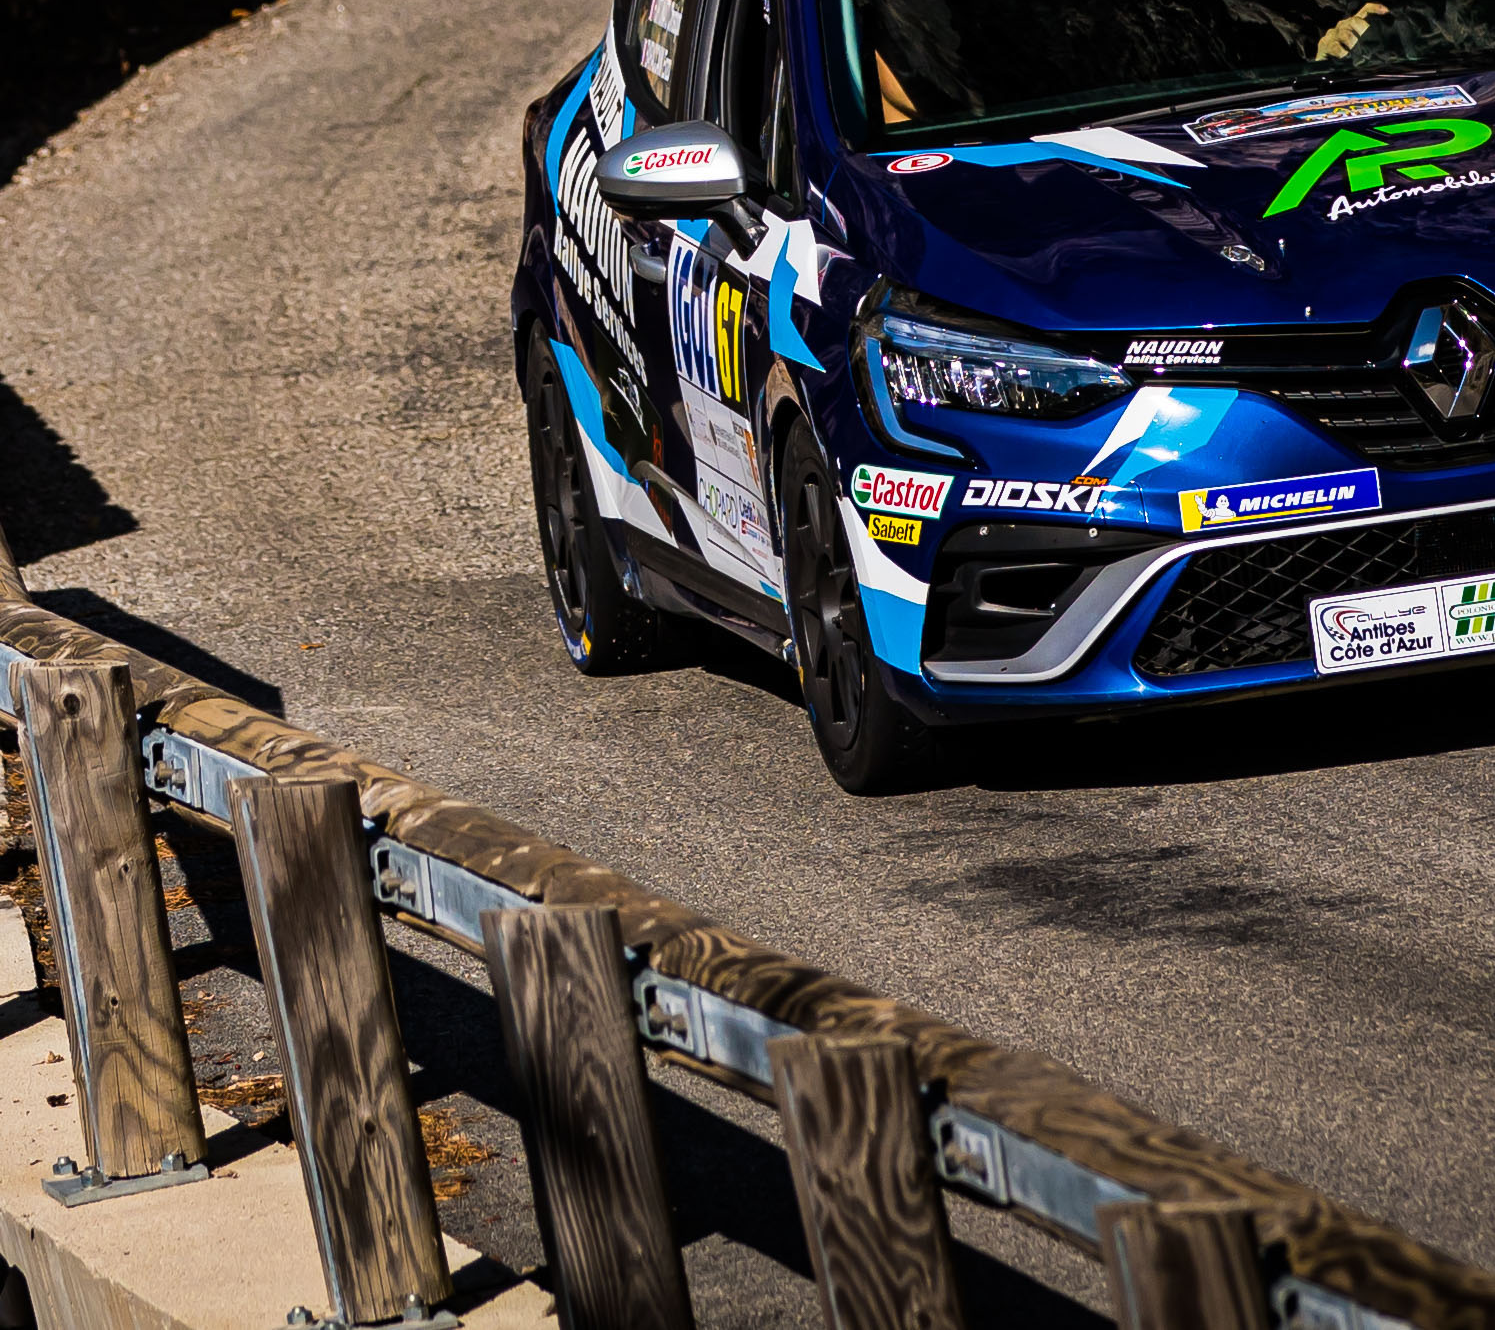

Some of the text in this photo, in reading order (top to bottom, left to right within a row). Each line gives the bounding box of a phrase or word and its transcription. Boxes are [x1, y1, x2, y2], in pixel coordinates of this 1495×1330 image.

[644, 147, 713, 172] Castrol
[911, 157, 931, 169] E
[557, 127, 636, 329] NAUDON
[554, 216, 648, 388] Rallye Services
[716, 281, 743, 403] 67
[1126, 340, 1225, 355] NAUDON
[1165, 354, 1221, 365] Services
[871, 477, 947, 514] Castrol
[1238, 484, 1356, 514] MICHELIN
[871, 516, 916, 543] Sabelt
[1350, 621, 1416, 643] Antibes
[1330, 636, 1434, 662] Côte d'Azur
